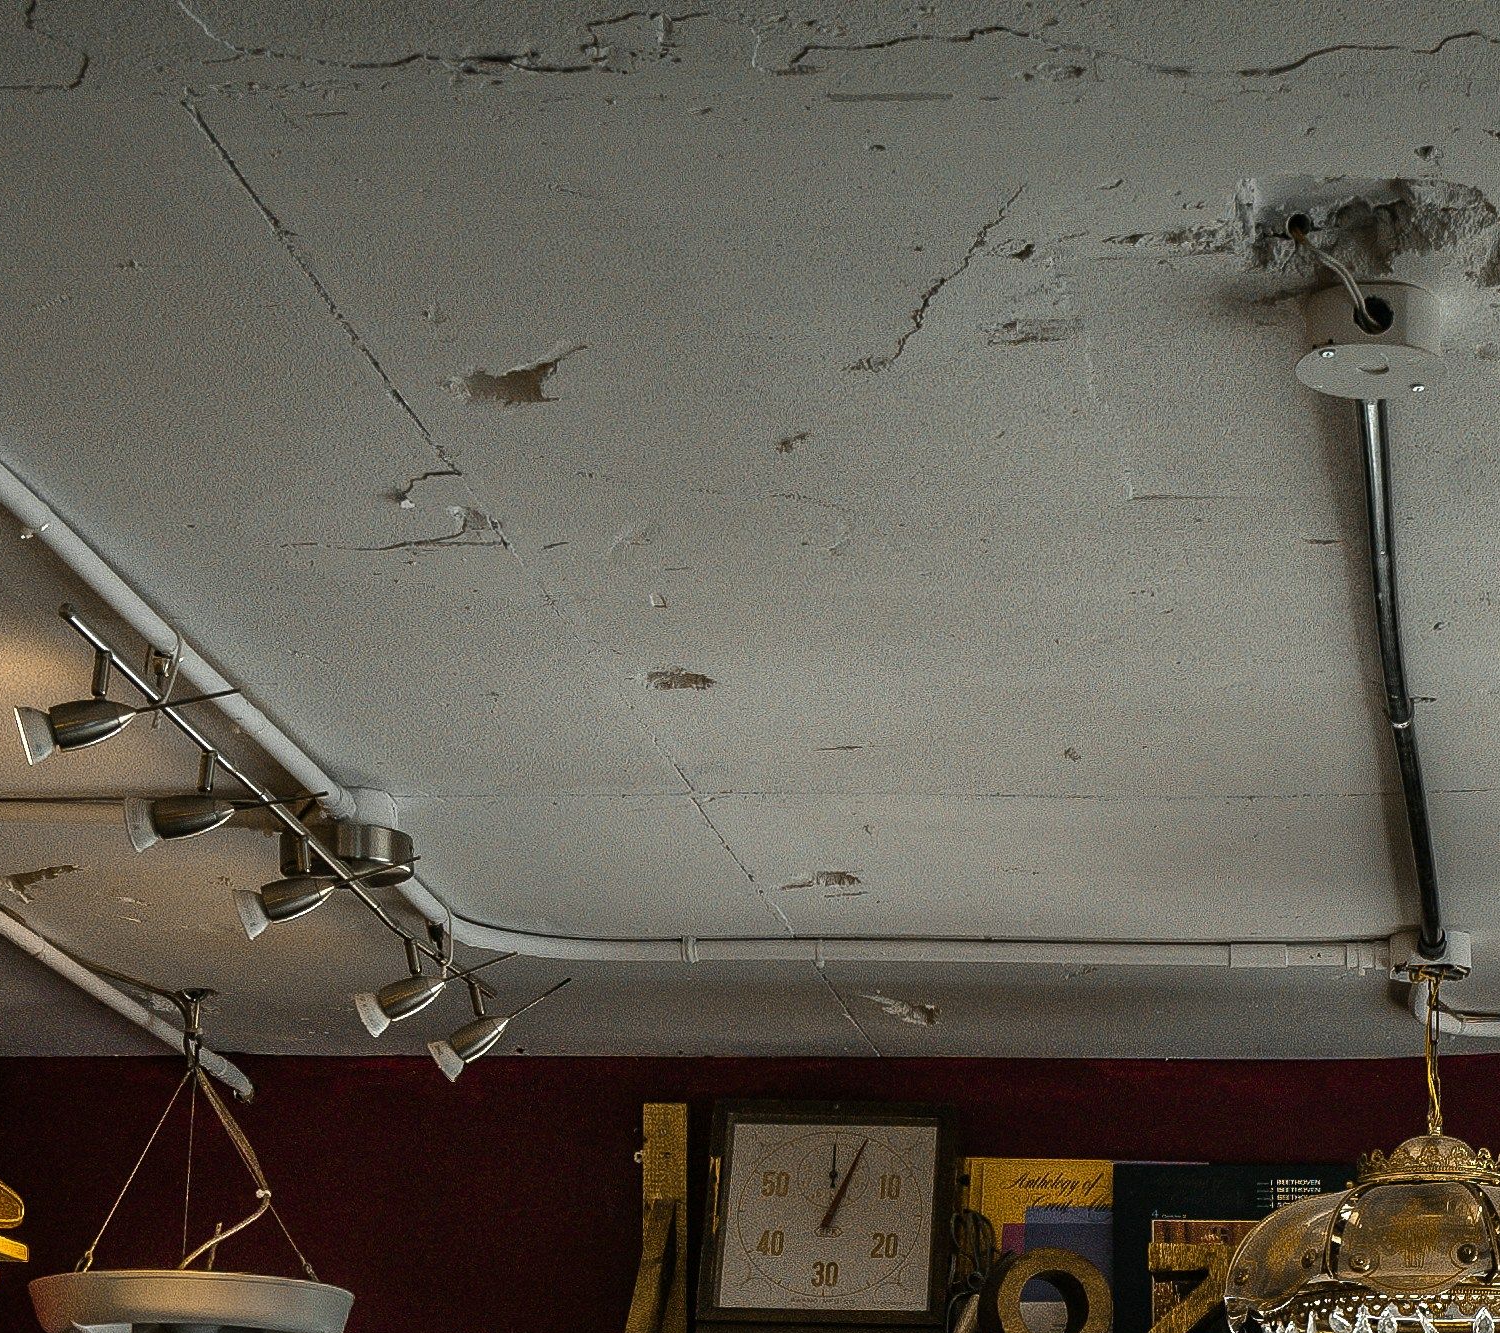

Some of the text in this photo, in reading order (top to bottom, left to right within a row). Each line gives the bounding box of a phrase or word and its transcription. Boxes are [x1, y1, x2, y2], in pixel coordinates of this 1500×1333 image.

[760, 1171, 790, 1198] 50
[879, 1174, 901, 1201] 10
[1082, 1172, 1104, 1197] of
[756, 1230, 785, 1257] 40
[870, 1232, 899, 1259] 20
[811, 1260, 839, 1288] 30
